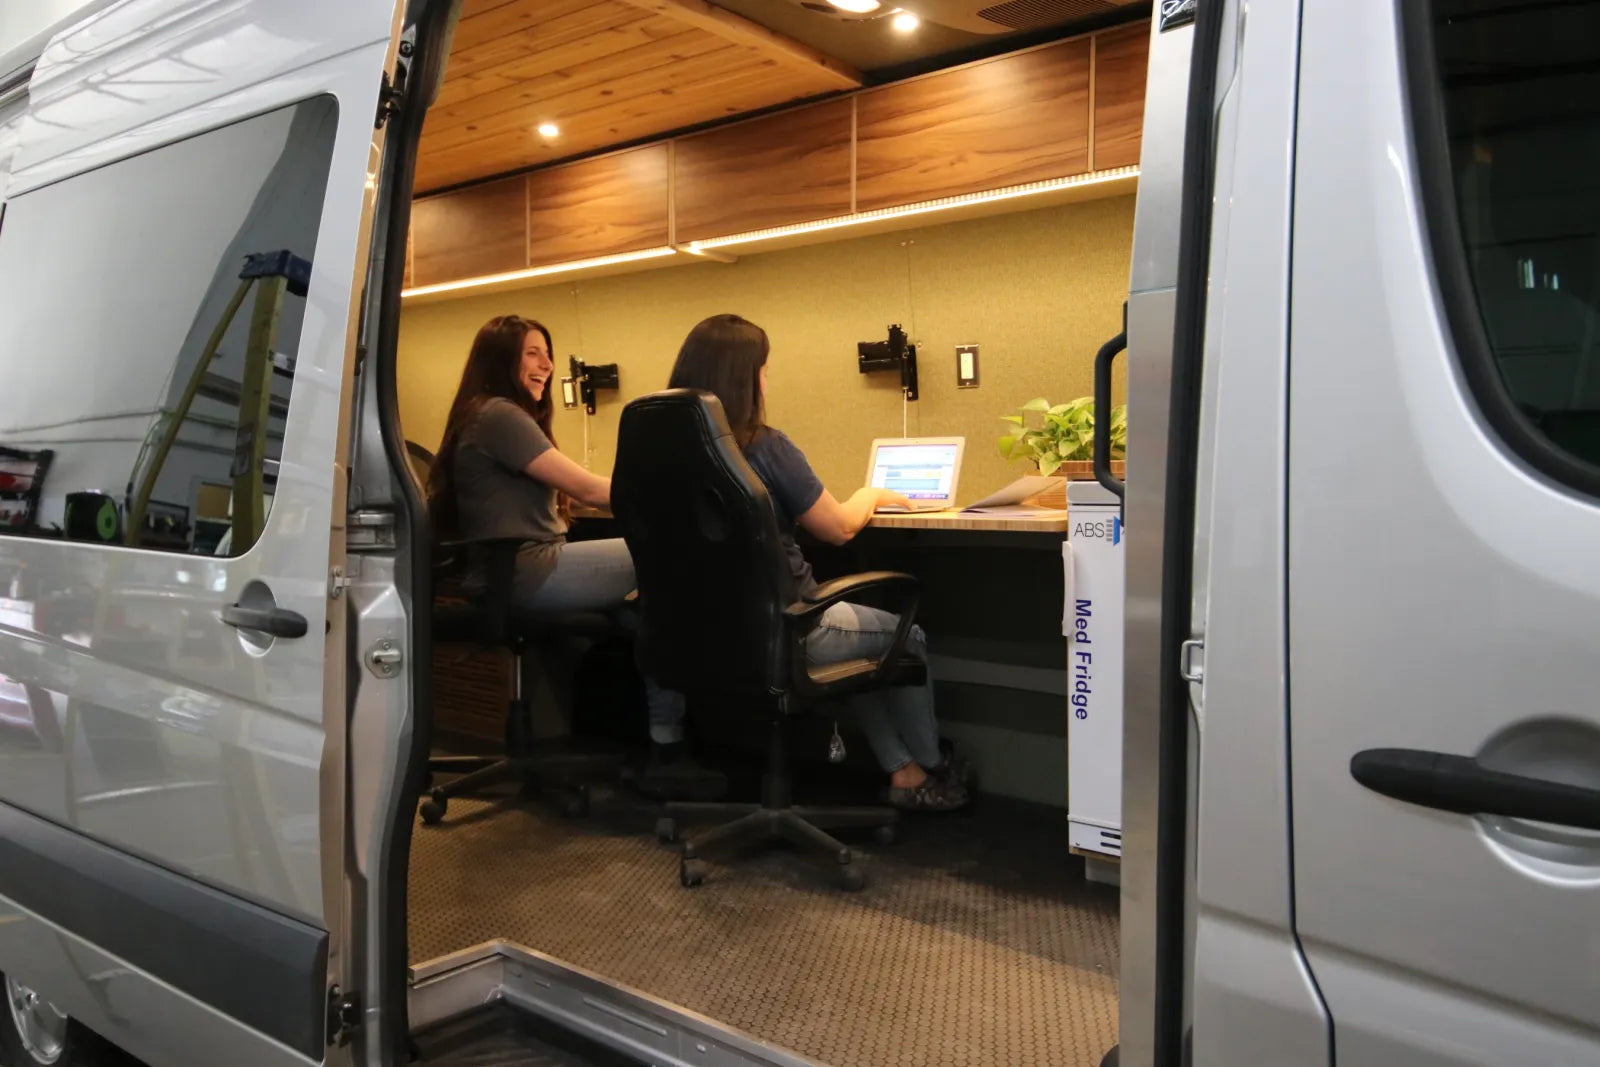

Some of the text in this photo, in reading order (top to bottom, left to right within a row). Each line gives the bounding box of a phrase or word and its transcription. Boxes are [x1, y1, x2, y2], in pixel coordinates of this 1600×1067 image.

[1074, 522, 1105, 538] ABS
[1071, 599, 1092, 720] Med Fridge
